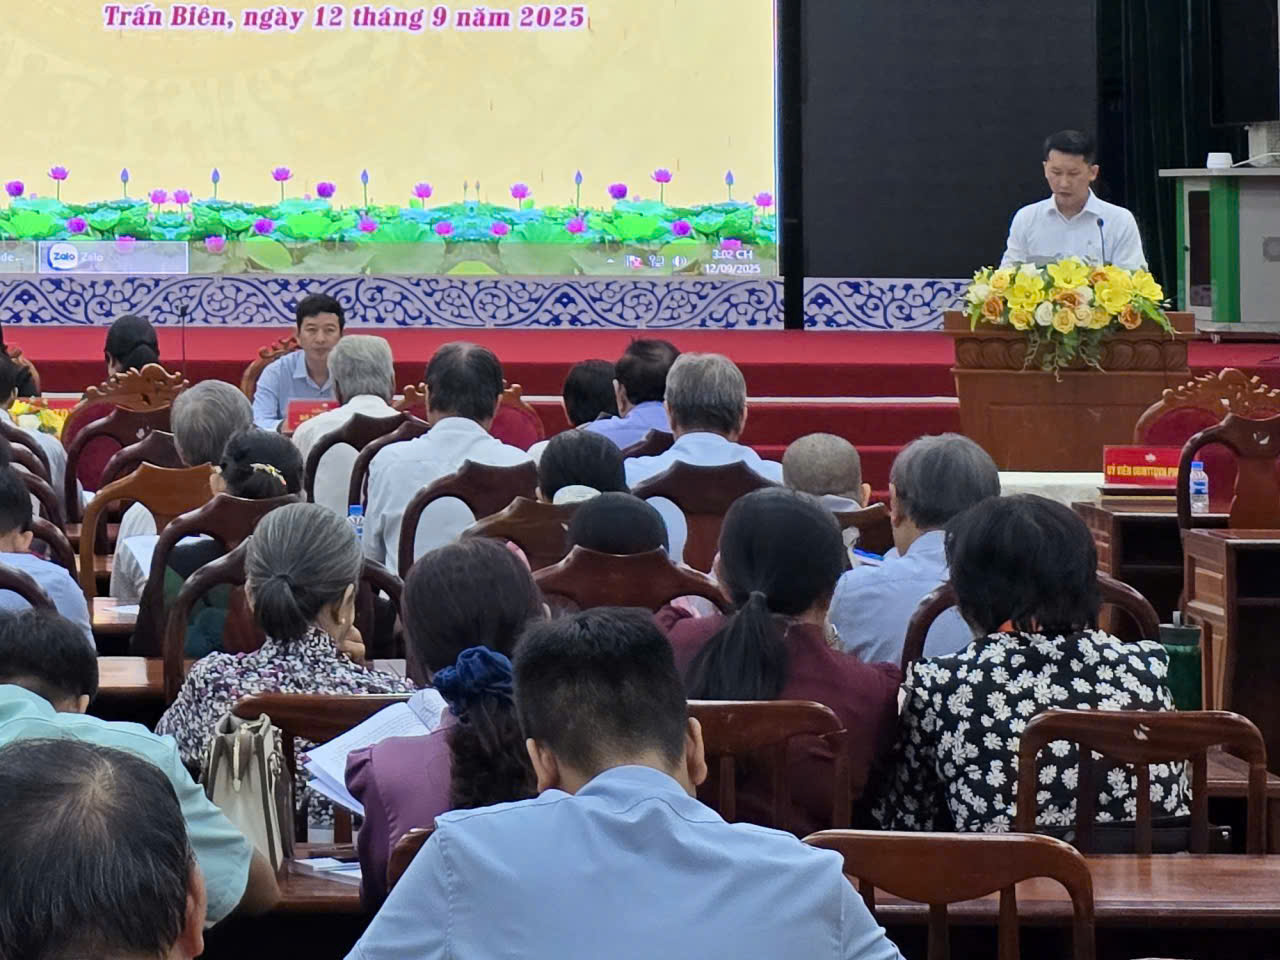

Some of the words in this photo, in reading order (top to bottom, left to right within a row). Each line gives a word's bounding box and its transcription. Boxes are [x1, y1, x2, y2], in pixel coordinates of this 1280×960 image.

[105, 3, 162, 27] Trấn
[171, 6, 234, 30] Biên,
[243, 7, 305, 30] ngày
[314, 6, 343, 26] 12
[353, 5, 422, 30] tháng
[433, 6, 447, 27] 9
[456, 6, 510, 27] năm
[520, 6, 585, 27] 2025
